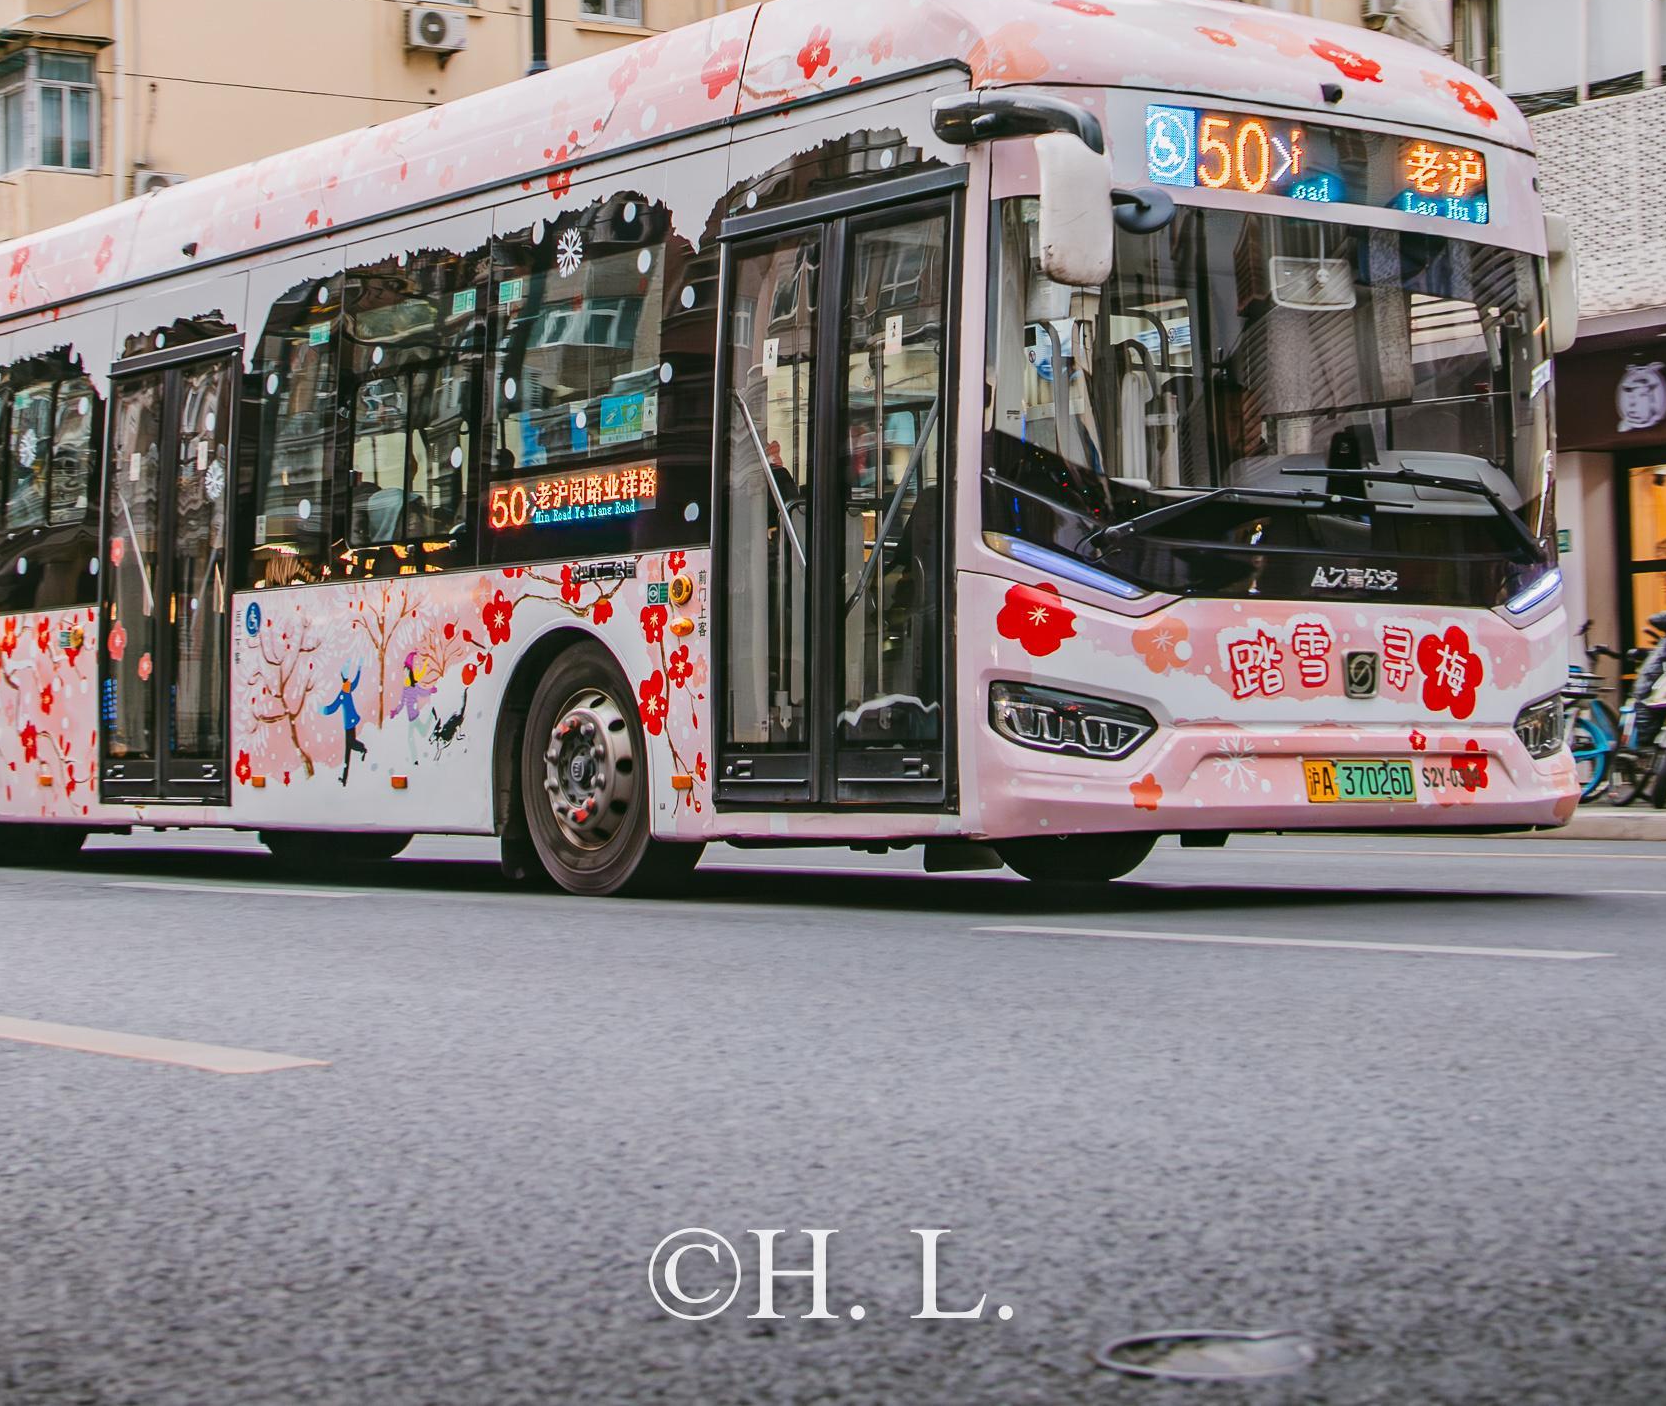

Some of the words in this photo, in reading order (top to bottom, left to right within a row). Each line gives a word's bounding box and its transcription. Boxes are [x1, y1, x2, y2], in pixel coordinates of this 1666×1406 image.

[1198, 116, 1270, 193] 50
[1405, 143, 1484, 197] 老沪
[1292, 178, 1331, 202] oad
[1404, 192, 1438, 216] Lao
[1446, 197, 1471, 221] Hu
[491, 486, 527, 528] 50
[553, 506, 572, 522] Road
[575, 505, 585, 519] Ye
[587, 503, 613, 518] Xiang
[615, 499, 636, 514] Road
